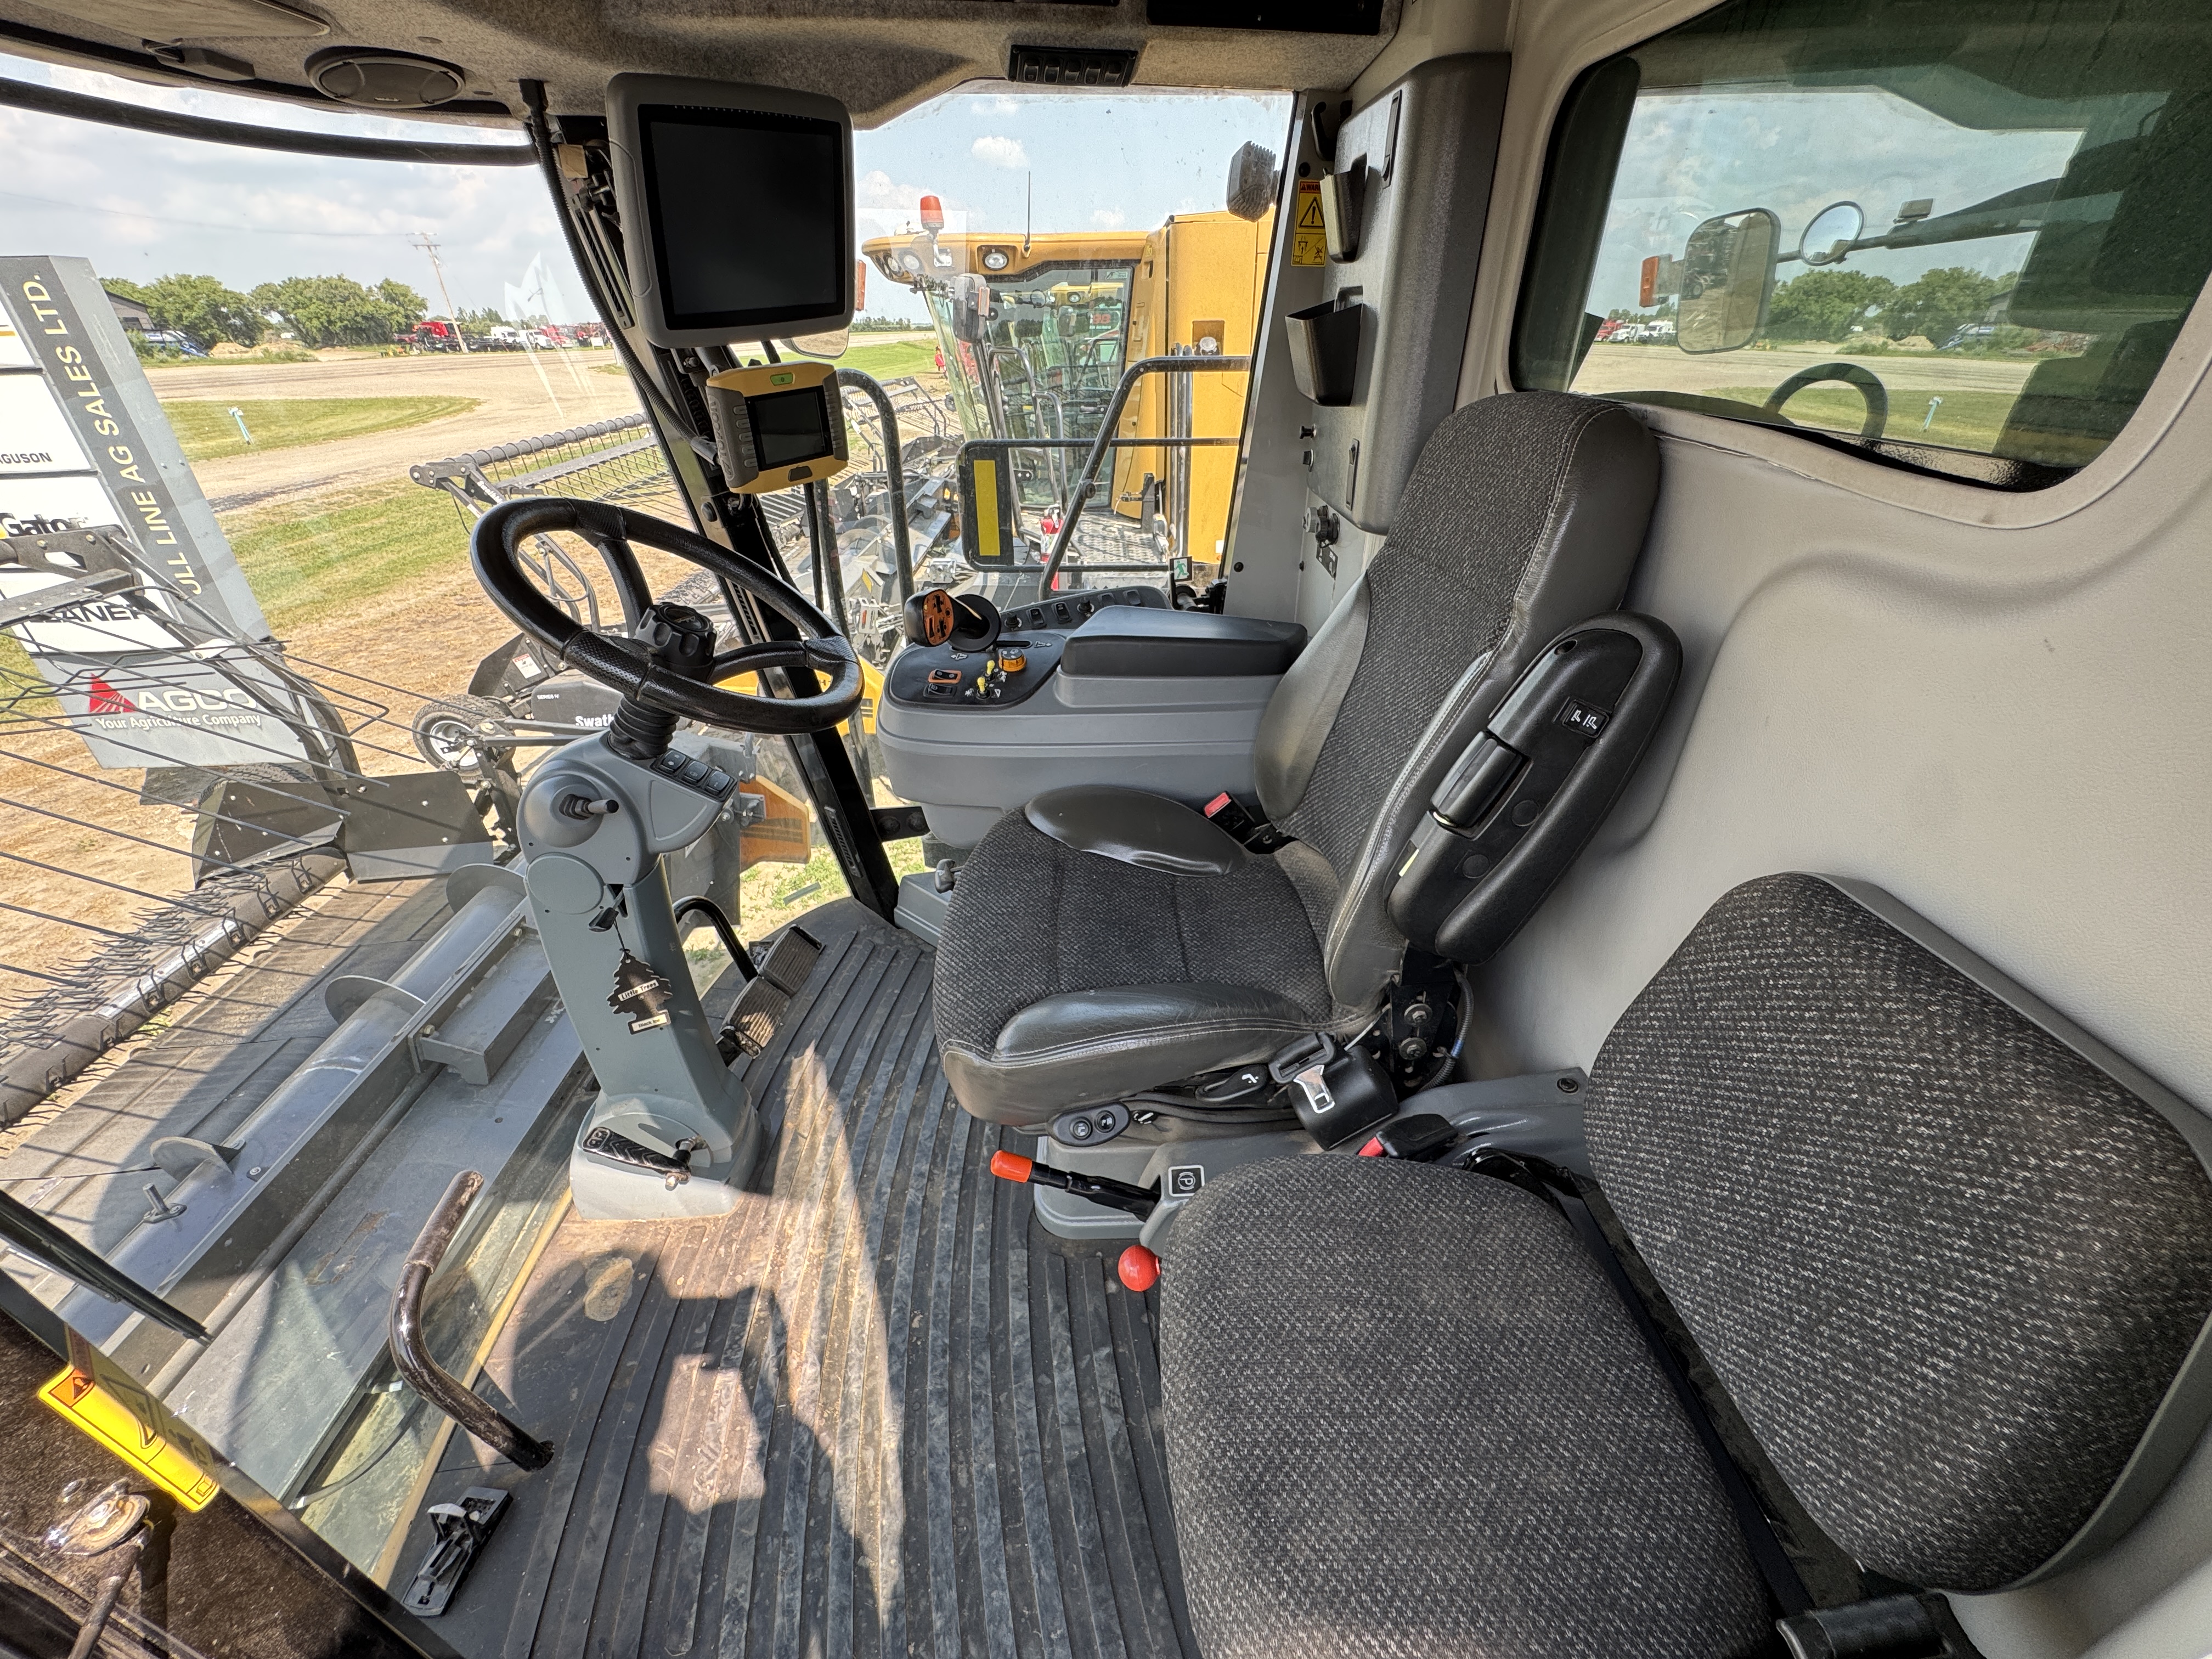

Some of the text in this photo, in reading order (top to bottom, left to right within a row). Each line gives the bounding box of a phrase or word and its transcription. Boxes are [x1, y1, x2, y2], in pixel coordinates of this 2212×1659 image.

[23, 275, 68, 335] LTD.
[55, 345, 120, 436] SALES
[0, 452, 53, 464] GUSON
[109, 445, 145, 483] AG
[131, 490, 177, 544] LINE
[139, 688, 257, 712] AGCO
[95, 714, 262, 730] Your Agriculture Company
[621, 982, 657, 1000] Little Trees
